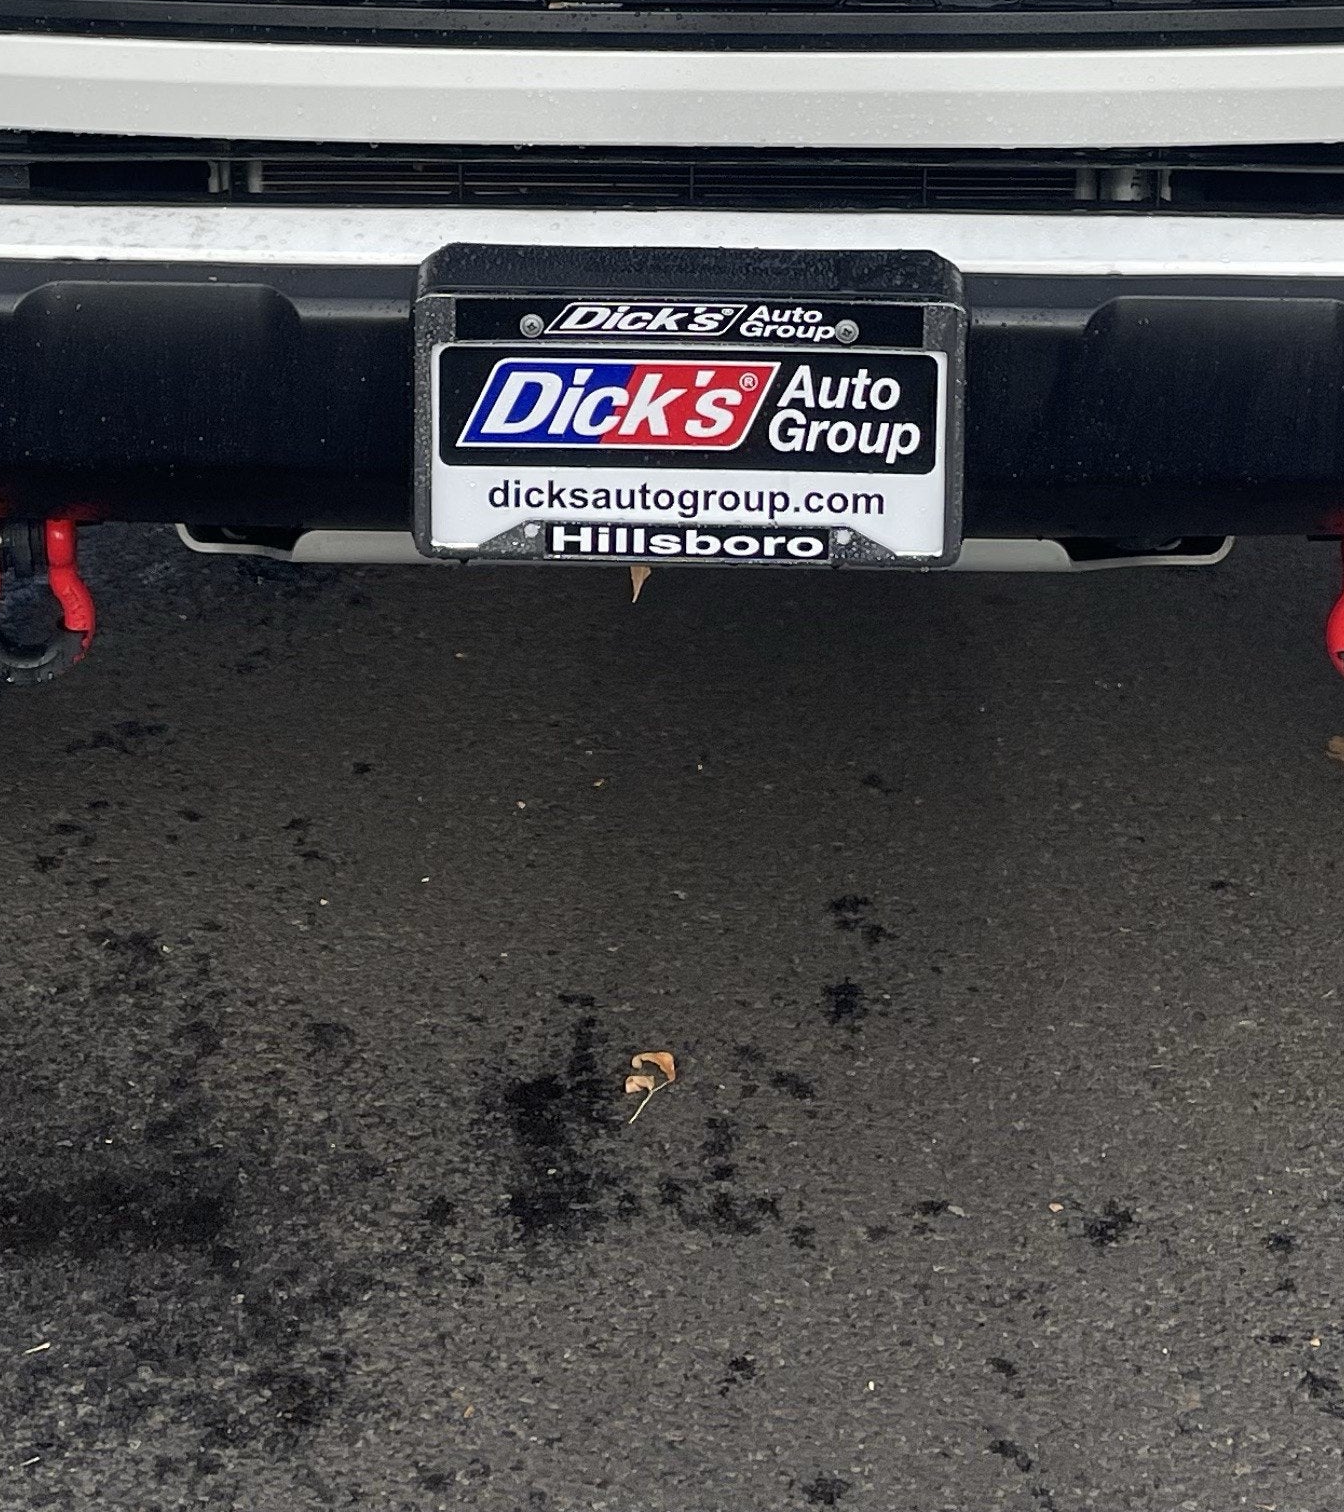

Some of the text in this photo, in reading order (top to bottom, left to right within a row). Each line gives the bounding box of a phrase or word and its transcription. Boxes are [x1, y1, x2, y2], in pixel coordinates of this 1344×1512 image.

[559, 305, 823, 332] Dick's Auto
[740, 321, 836, 341] Group
[479, 364, 902, 438] Dick's Auto
[768, 409, 921, 464] Group
[488, 479, 886, 519] dicksautogroup.com
[552, 527, 825, 559] Hillsboro
